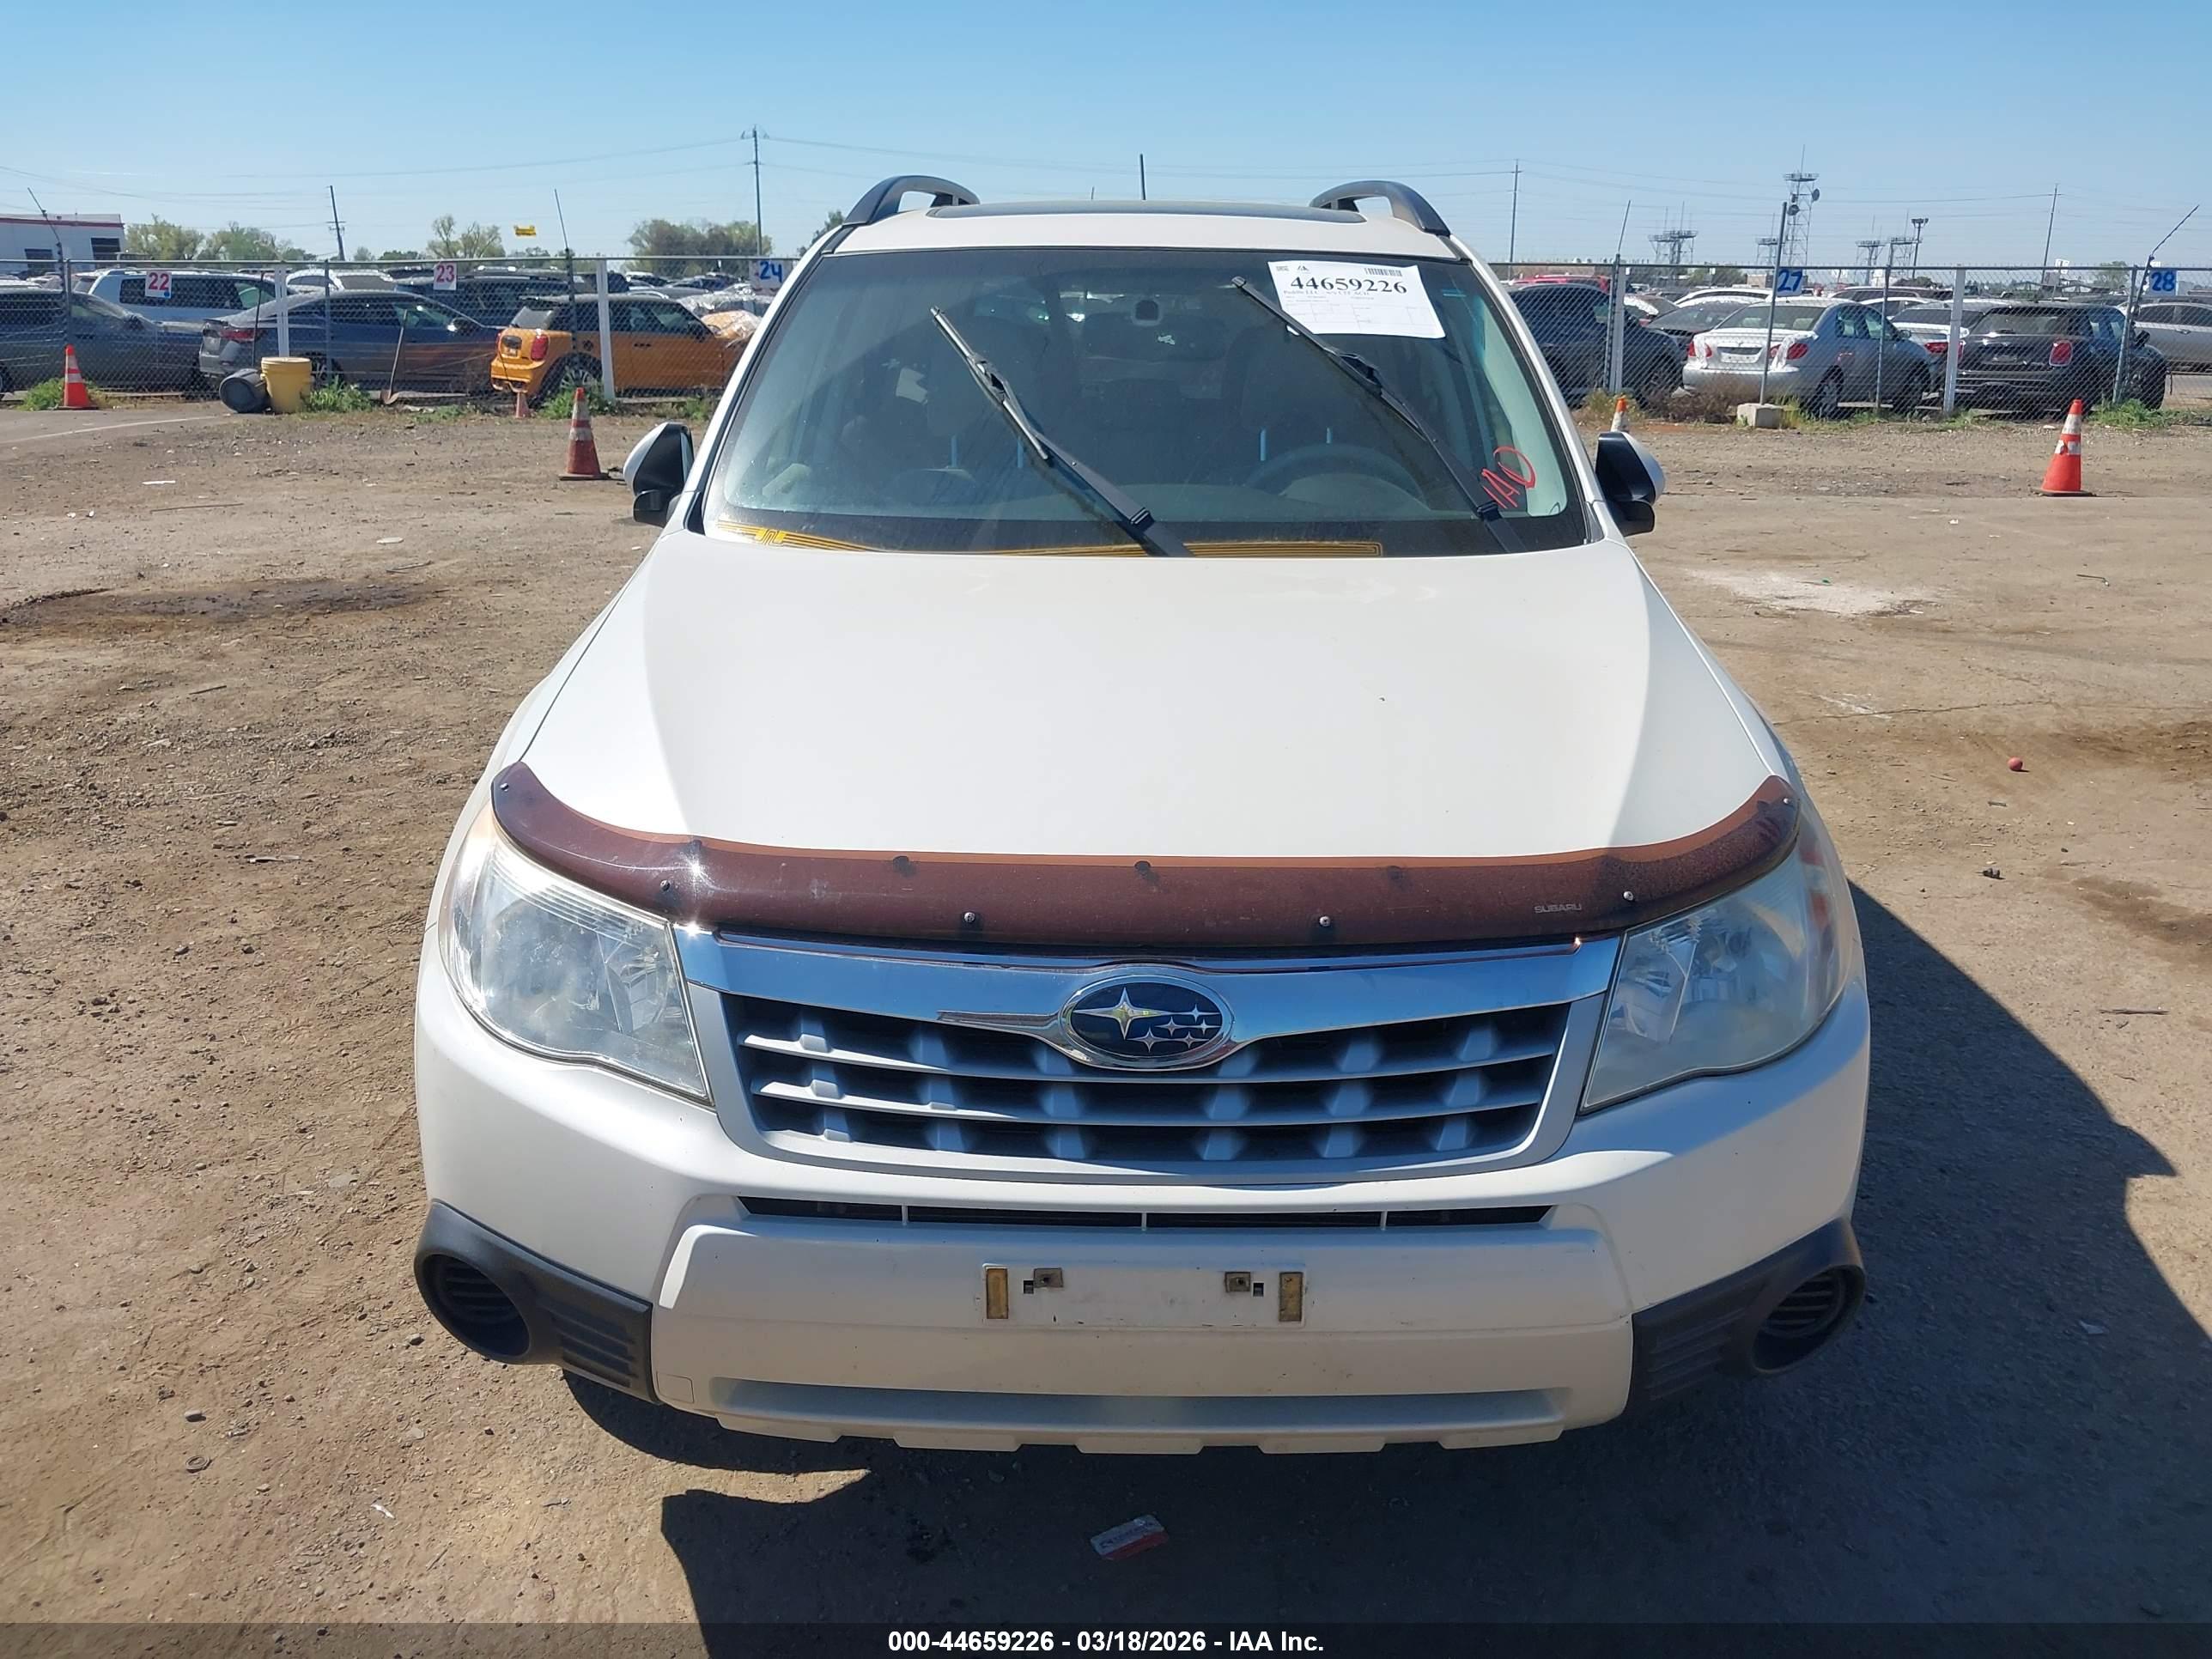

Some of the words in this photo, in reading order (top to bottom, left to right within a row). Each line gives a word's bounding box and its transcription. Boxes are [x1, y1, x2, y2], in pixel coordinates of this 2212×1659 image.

[149, 271, 169, 291] 22
[436, 264, 455, 283] 23
[760, 261, 782, 283] 24
[1777, 269, 1803, 292] 27
[2151, 271, 2175, 292] 28
[1290, 276, 1408, 295] 44659226
[1534, 903, 1583, 914] SUBARU
